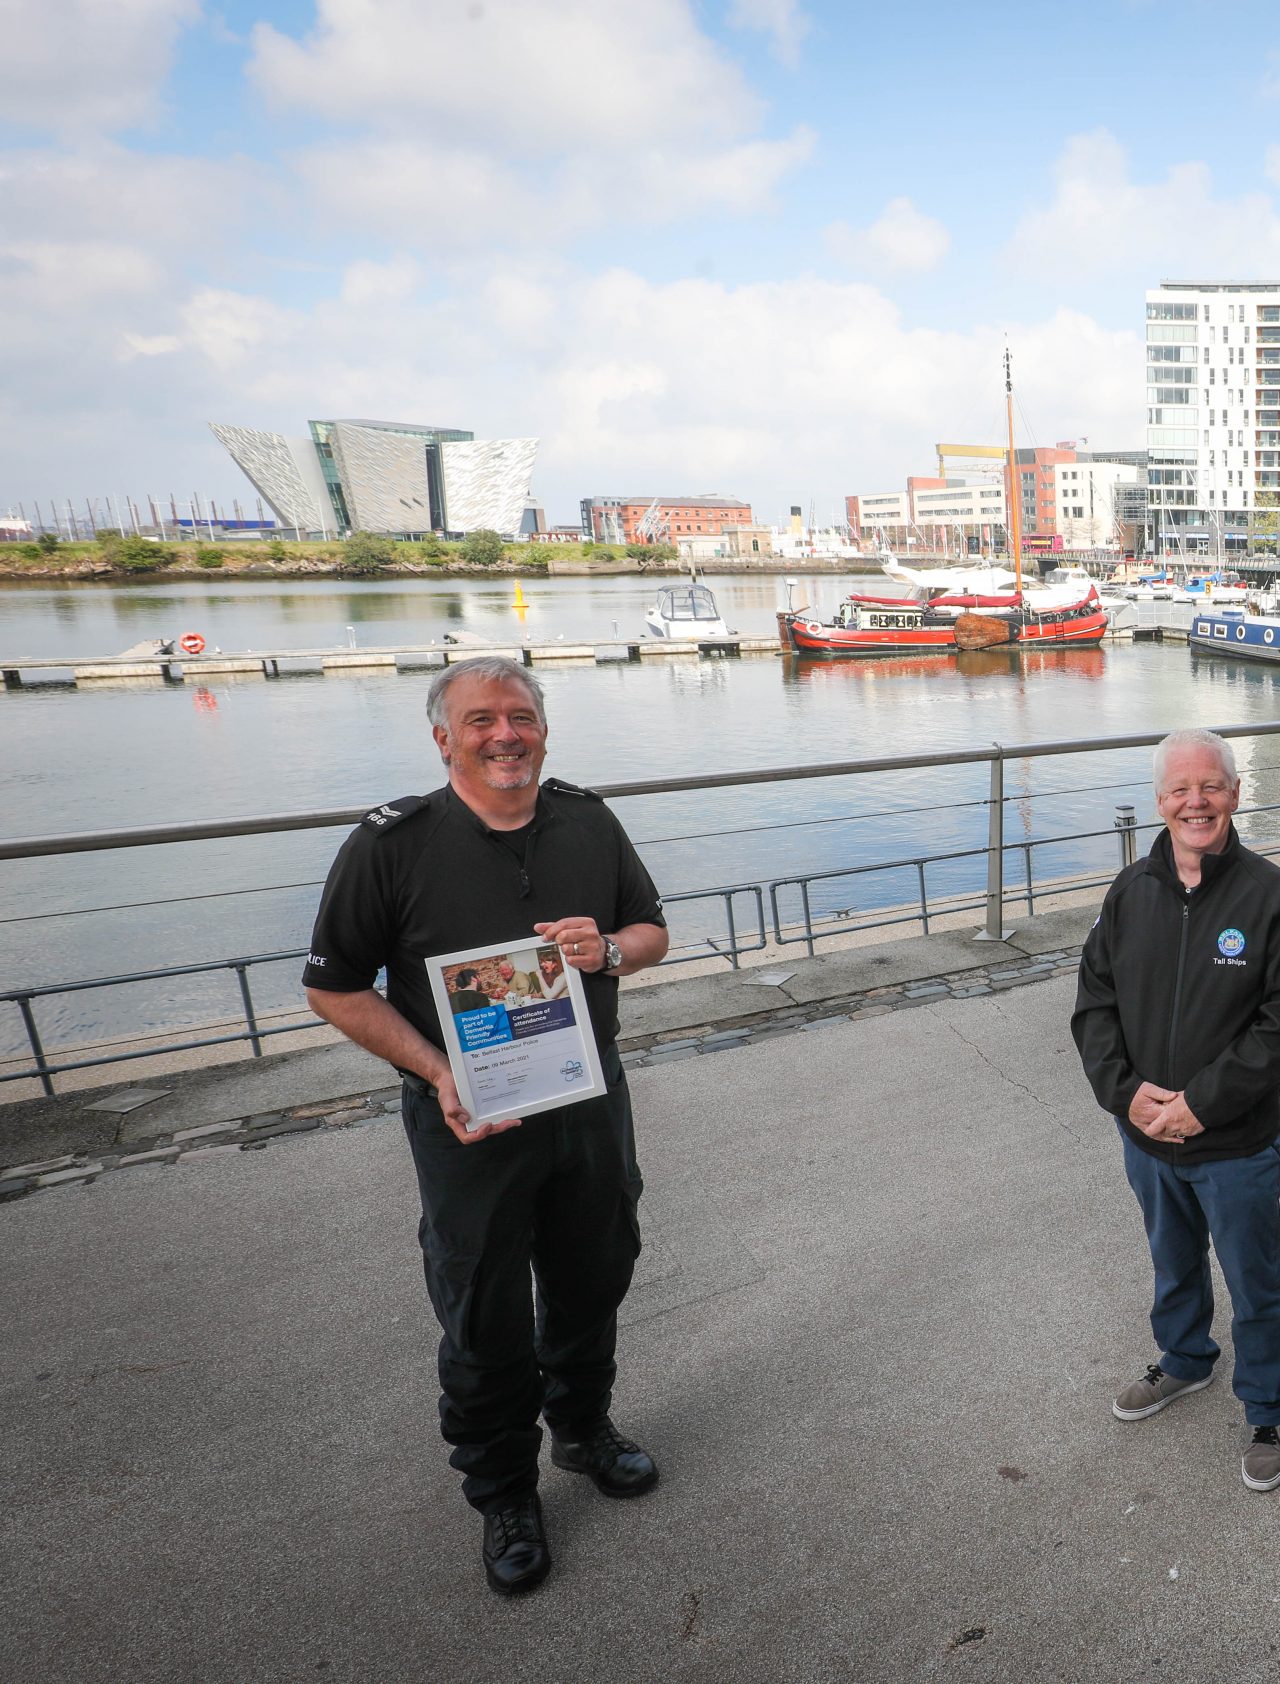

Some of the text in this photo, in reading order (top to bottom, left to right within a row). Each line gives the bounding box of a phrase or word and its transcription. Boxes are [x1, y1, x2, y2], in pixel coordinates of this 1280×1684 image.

[308, 953, 327, 967] LICE
[1213, 957, 1247, 967] Tall Ships
[461, 1014, 480, 1023] Proud
[512, 1011, 543, 1021] Certificate
[463, 1022, 476, 1030] part
[514, 1016, 547, 1027] attendance
[464, 1024, 494, 1035] Dementia
[466, 1031, 490, 1040] Friendly
[467, 1034, 507, 1047] Communities
[482, 1048, 500, 1056] Belfast
[501, 1043, 522, 1052] Harbour
[474, 1065, 490, 1073] Date:
